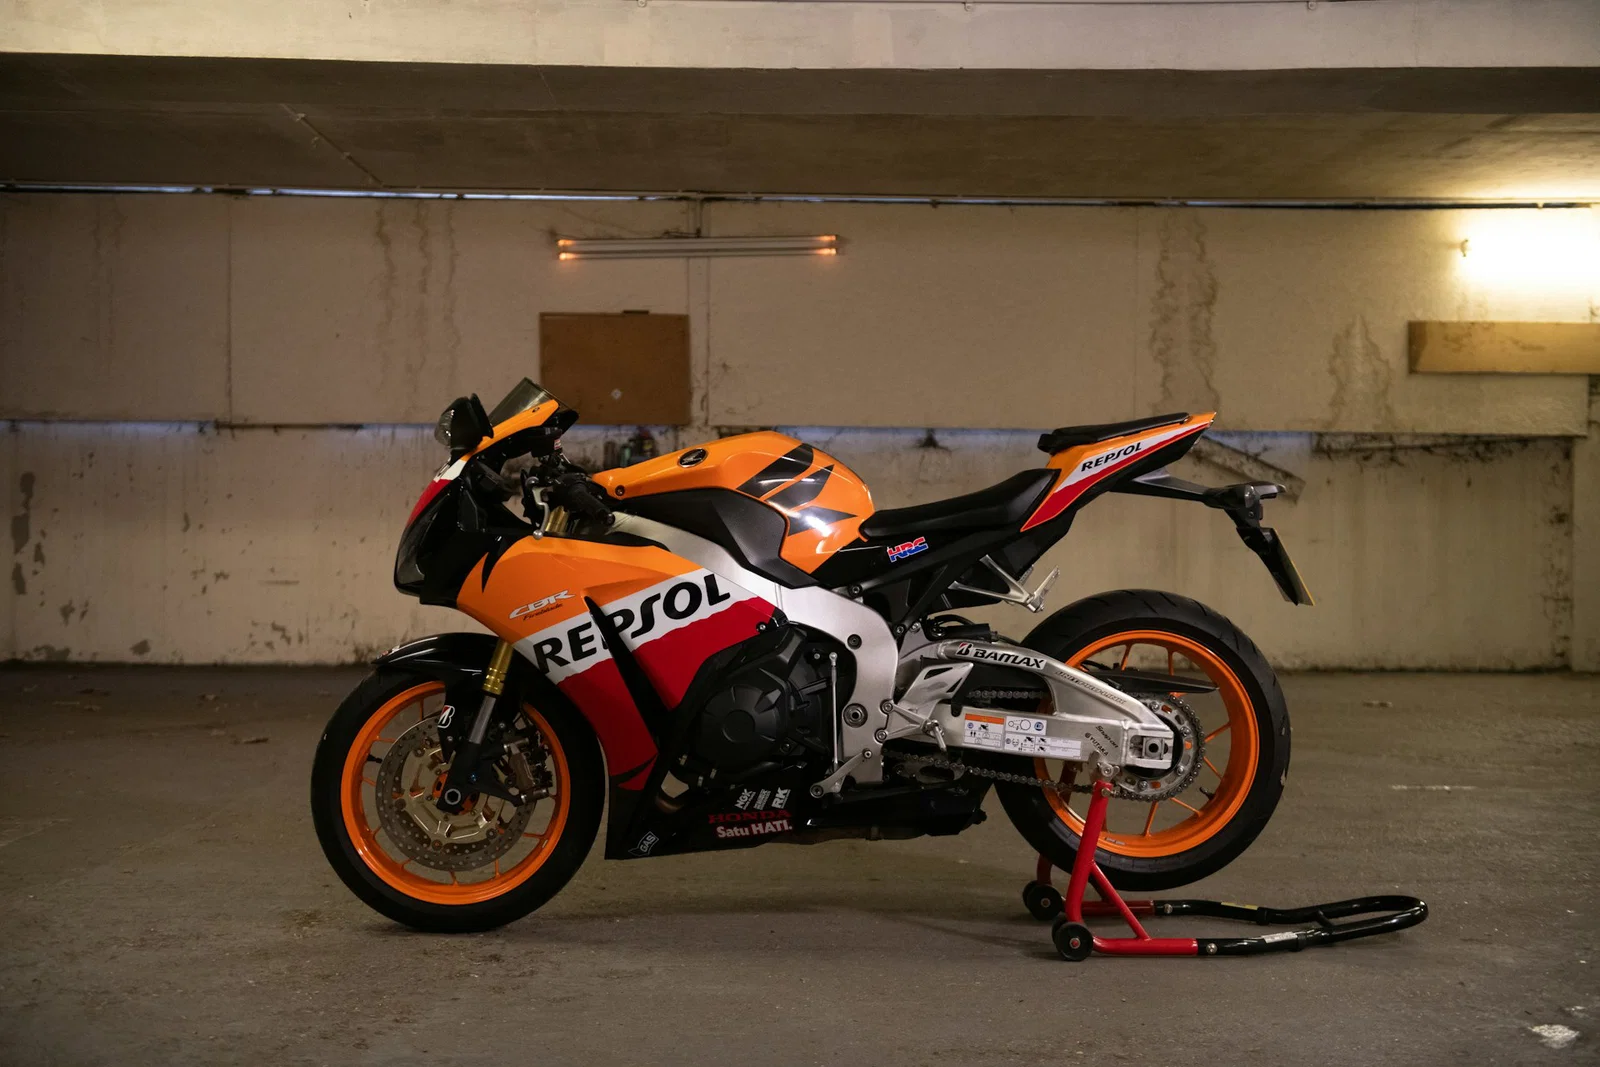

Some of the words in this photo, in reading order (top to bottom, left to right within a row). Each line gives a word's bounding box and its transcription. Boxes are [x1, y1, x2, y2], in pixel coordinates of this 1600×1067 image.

[1081, 442, 1142, 472] REPSOL
[887, 536, 928, 563] HRC
[508, 589, 576, 620] CBR
[523, 603, 563, 621] Fireblade
[532, 573, 731, 674] REPSOL
[734, 788, 753, 809] NGK
[771, 786, 789, 808] RK
[708, 809, 792, 824] HONDA
[716, 825, 750, 838] Satu
